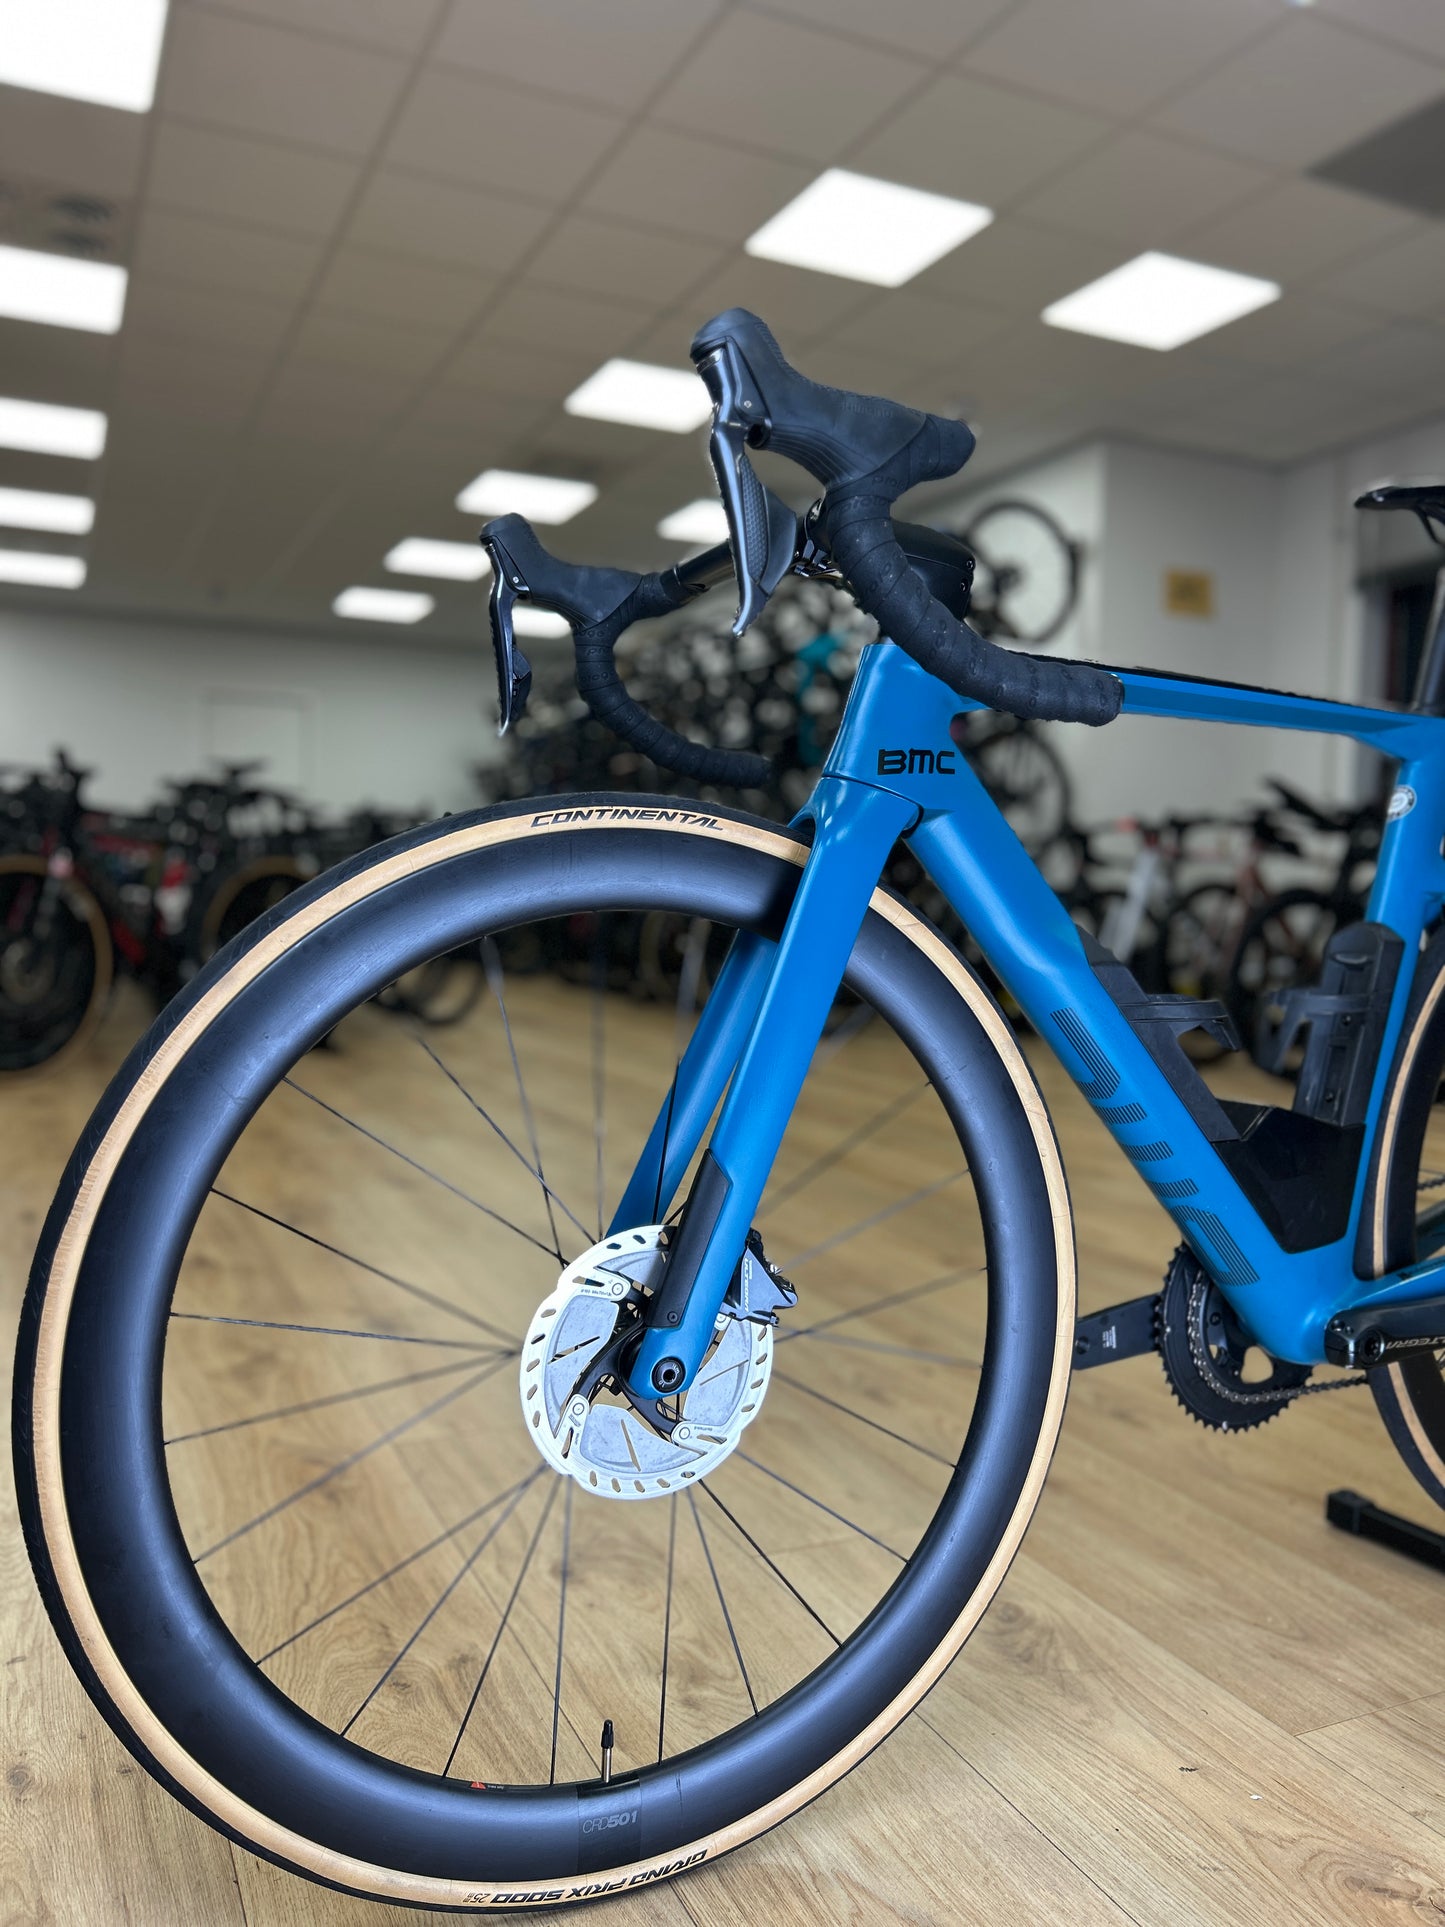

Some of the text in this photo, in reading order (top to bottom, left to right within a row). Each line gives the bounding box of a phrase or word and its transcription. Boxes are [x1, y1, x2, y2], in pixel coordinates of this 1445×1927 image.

[877, 749, 955, 775] BMC
[531, 809, 723, 831] CONTINENTAL
[1385, 1336, 1445, 1349] LTEGRA
[583, 1811, 638, 1834] CRD501
[629, 1849, 708, 1885] GRAND
[490, 1889, 565, 1904] 5000
[566, 1878, 627, 1898] PRIX
